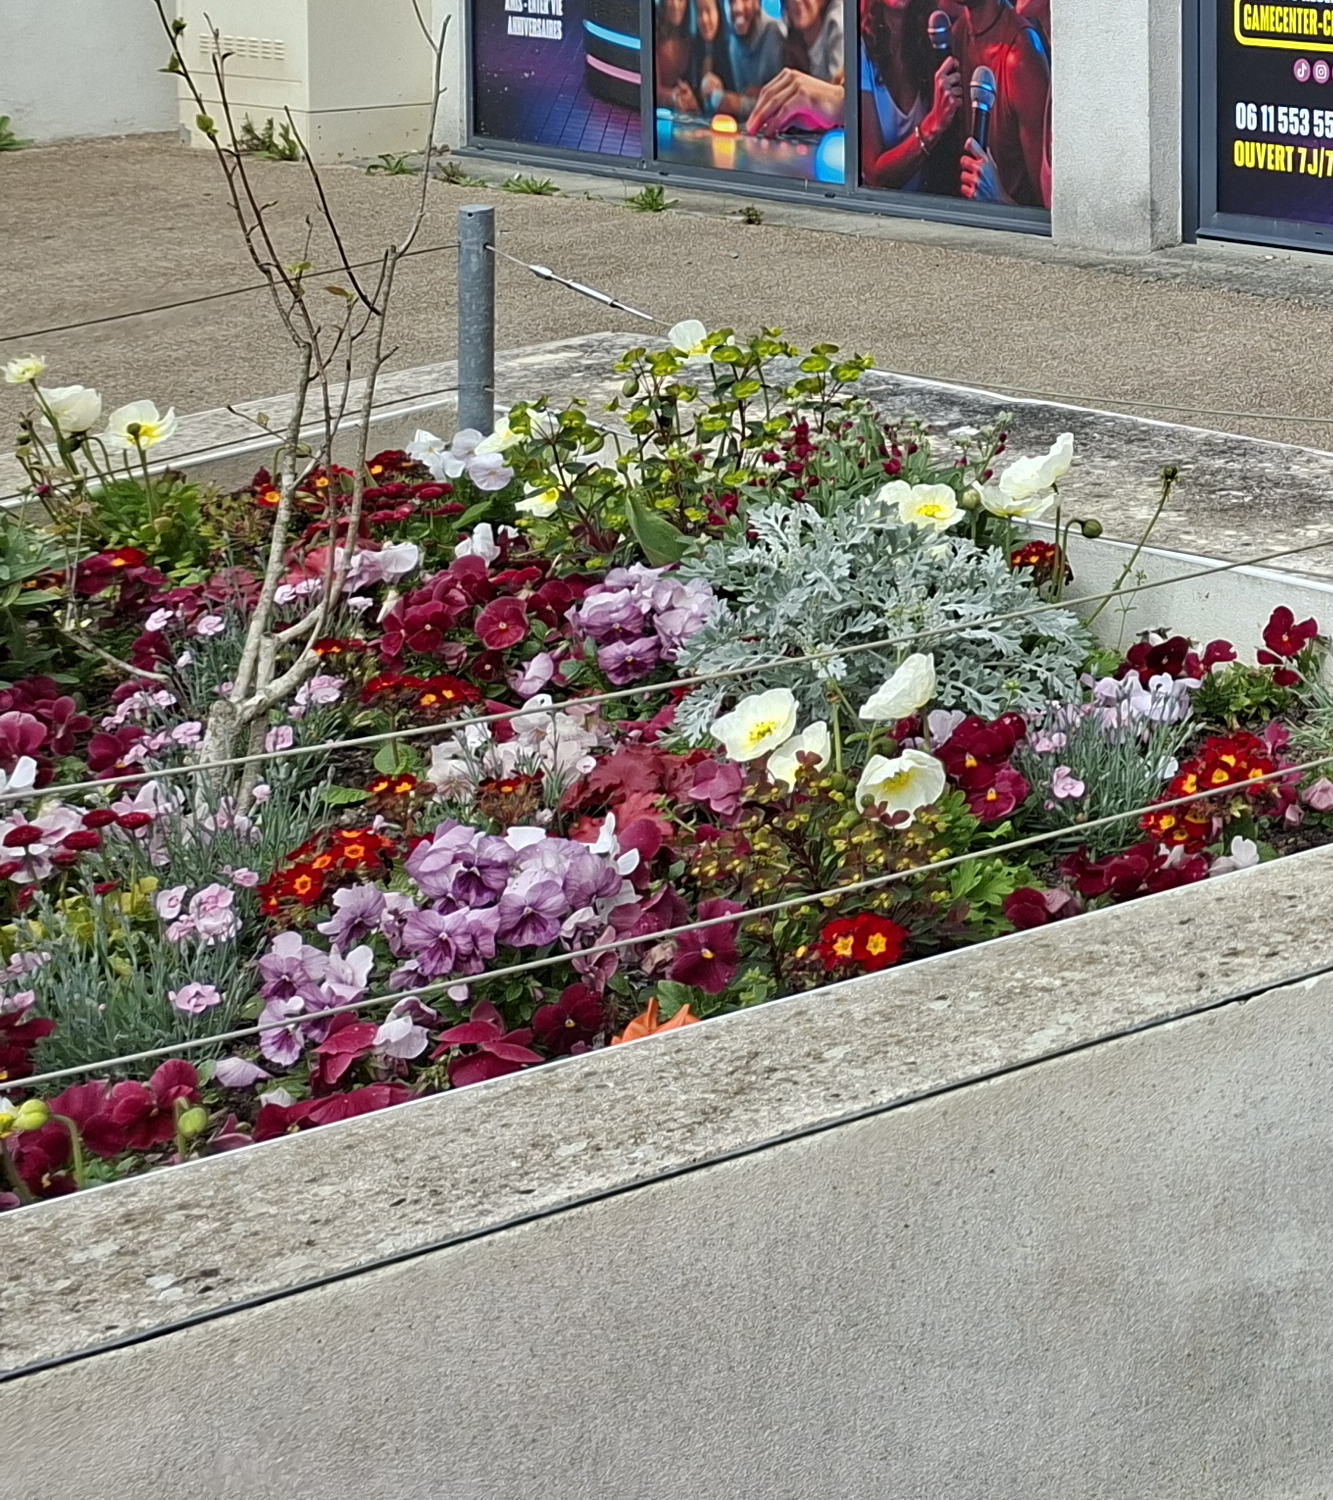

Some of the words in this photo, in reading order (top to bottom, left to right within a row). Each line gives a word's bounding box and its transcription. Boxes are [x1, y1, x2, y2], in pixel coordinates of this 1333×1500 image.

[1235, 102, 1257, 130] 06
[1260, 104, 1275, 132] 11
[1278, 105, 1310, 136] 553
[1233, 139, 1294, 173] OUVERT
